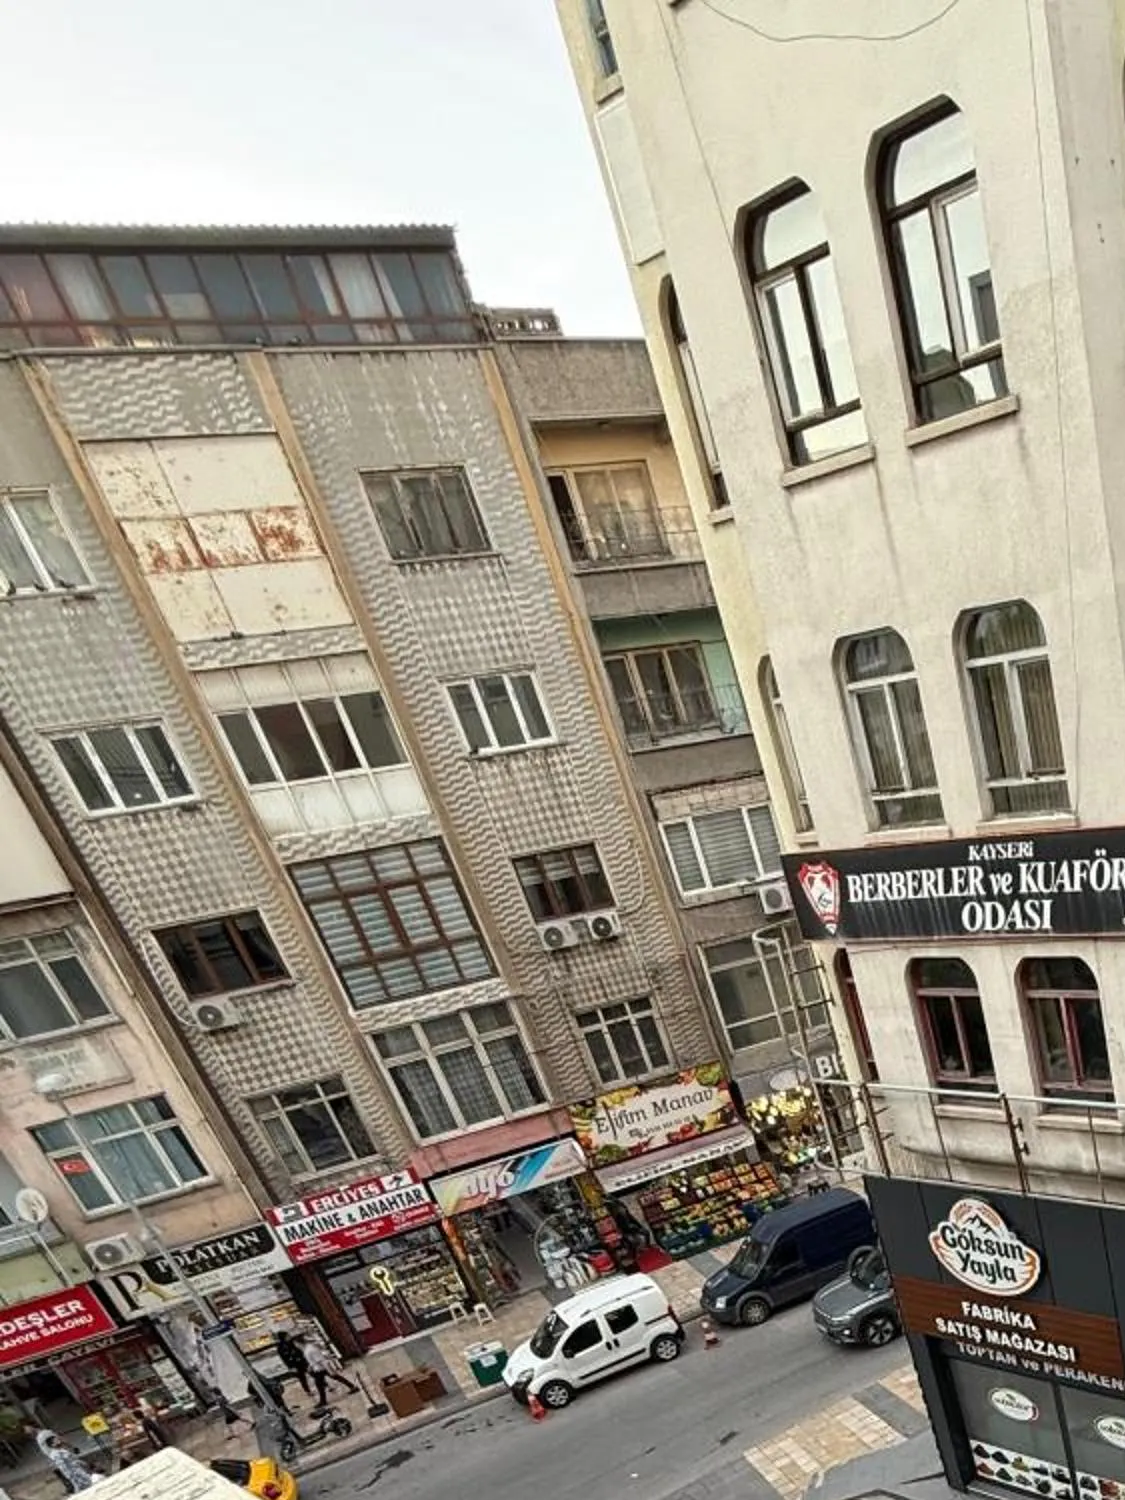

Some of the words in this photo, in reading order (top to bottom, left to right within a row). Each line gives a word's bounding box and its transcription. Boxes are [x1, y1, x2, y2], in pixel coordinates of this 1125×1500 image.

[968, 841, 1034, 860] KAYSERİ
[847, 865, 986, 902] BERBERLER
[988, 873, 1013, 896] ve
[961, 899, 1053, 932] ODASI
[650, 1088, 714, 1117] Manav
[309, 1180, 381, 1213] ERCİYES
[283, 1210, 345, 1244] MAKİNE
[358, 1187, 423, 1219] ANAHTAR
[941, 1225, 1026, 1263] Göksun
[956, 1249, 1017, 1285] Yayla
[0, 1299, 87, 1336] DEŞLER
[961, 1301, 1037, 1331] FABRİKA
[935, 1317, 983, 1342] SATIŞ
[985, 1327, 1077, 1362] MAĞAZASI
[957, 1341, 1018, 1365] TOPTAN
